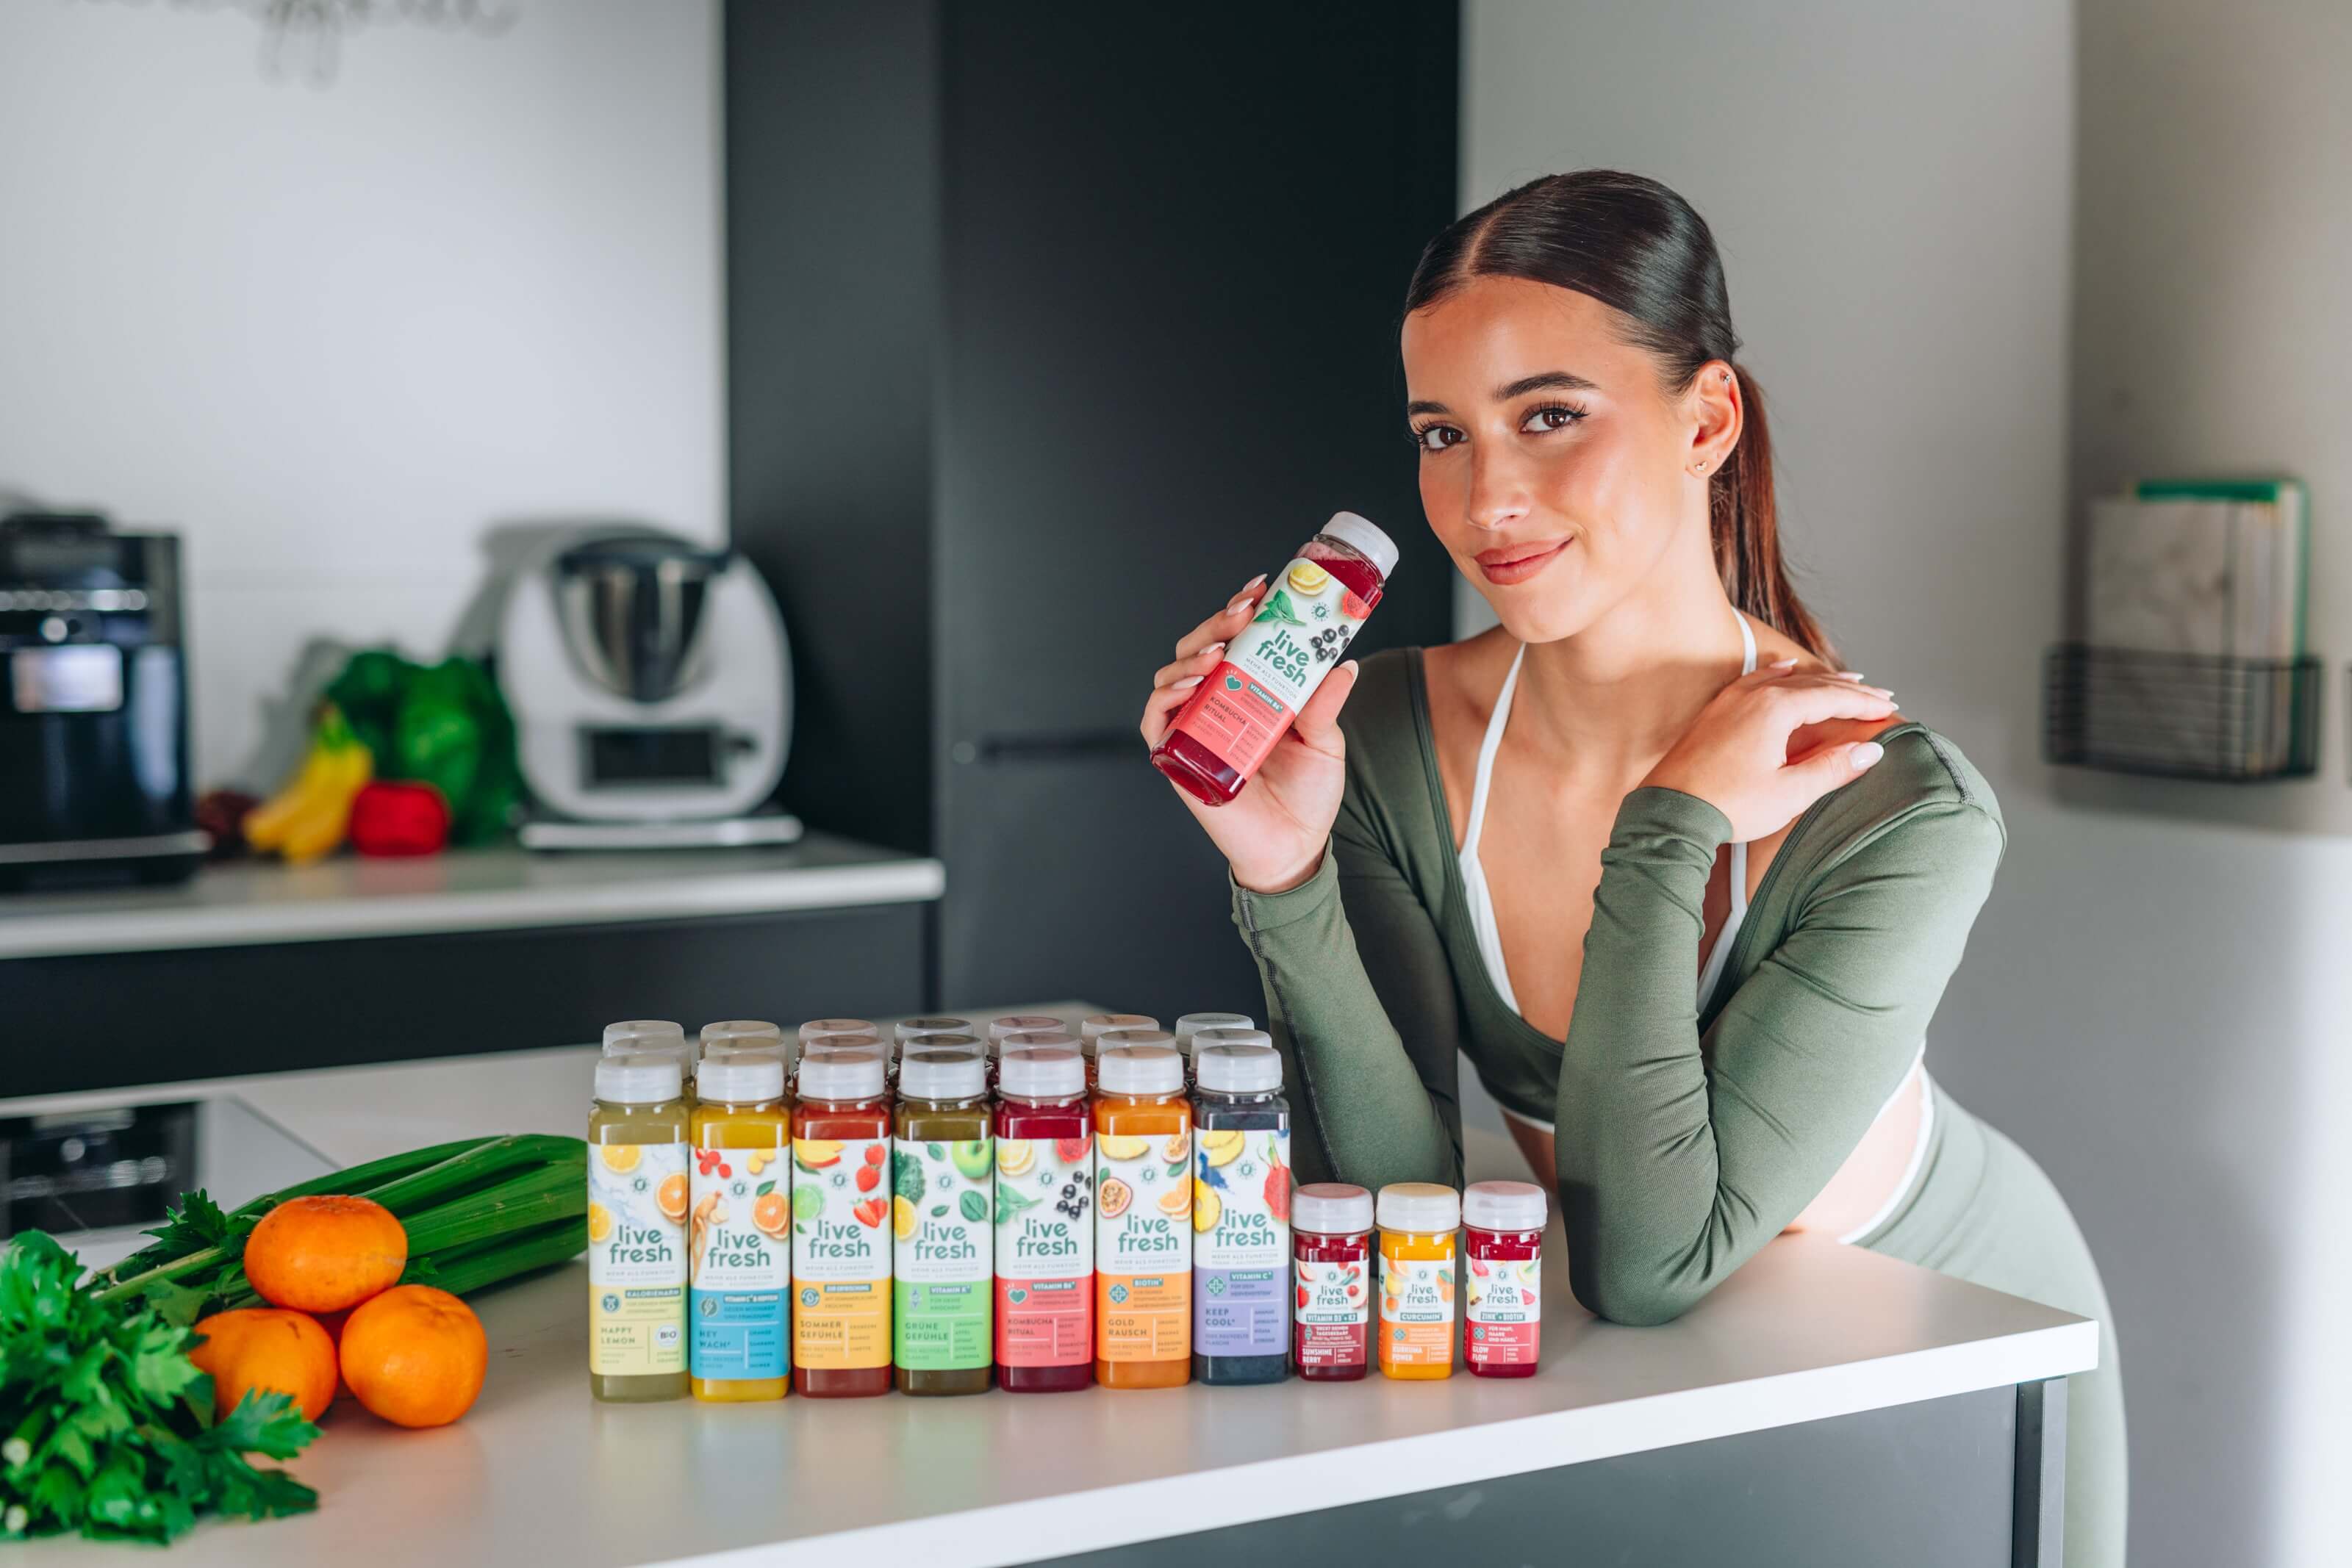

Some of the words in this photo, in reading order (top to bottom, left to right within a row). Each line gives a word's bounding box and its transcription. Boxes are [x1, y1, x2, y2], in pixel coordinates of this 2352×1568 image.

[1274, 629, 1310, 667] live
[1255, 640, 1307, 688] fresh
[1245, 657, 1261, 670] MEHR
[1261, 669, 1272, 678] ALS
[1270, 676, 1298, 699] FUNKTION
[1248, 683, 1274, 704] VITAMIN
[1204, 703, 1227, 722] RITUAL
[1209, 695, 1247, 725] KOMBUCHA
[1025, 1218, 1068, 1238] live
[1127, 1214, 1169, 1234] live
[1225, 1209, 1266, 1229] live
[618, 1225, 662, 1245] live
[717, 1229, 761, 1248] live
[817, 1219, 861, 1240] live
[924, 1221, 967, 1242] live
[1216, 1227, 1275, 1248] fresh
[809, 1238, 870, 1259] fresh
[915, 1240, 975, 1261] fresh
[1017, 1237, 1078, 1257] fresh
[1119, 1232, 1178, 1253] fresh
[610, 1243, 672, 1264] fresh
[709, 1247, 770, 1268] fresh
[1317, 1293, 1348, 1305] fresh
[1321, 1285, 1343, 1295] live
[1407, 1293, 1438, 1303] fresh
[1411, 1284, 1433, 1295] live
[1487, 1294, 1518, 1304] fresh
[1491, 1284, 1513, 1294] live
[700, 1330, 717, 1338] HEY
[800, 1330, 842, 1339] GEFÜHLE
[906, 1322, 939, 1330] GRÜNE
[906, 1331, 947, 1340] GEFÜHLE
